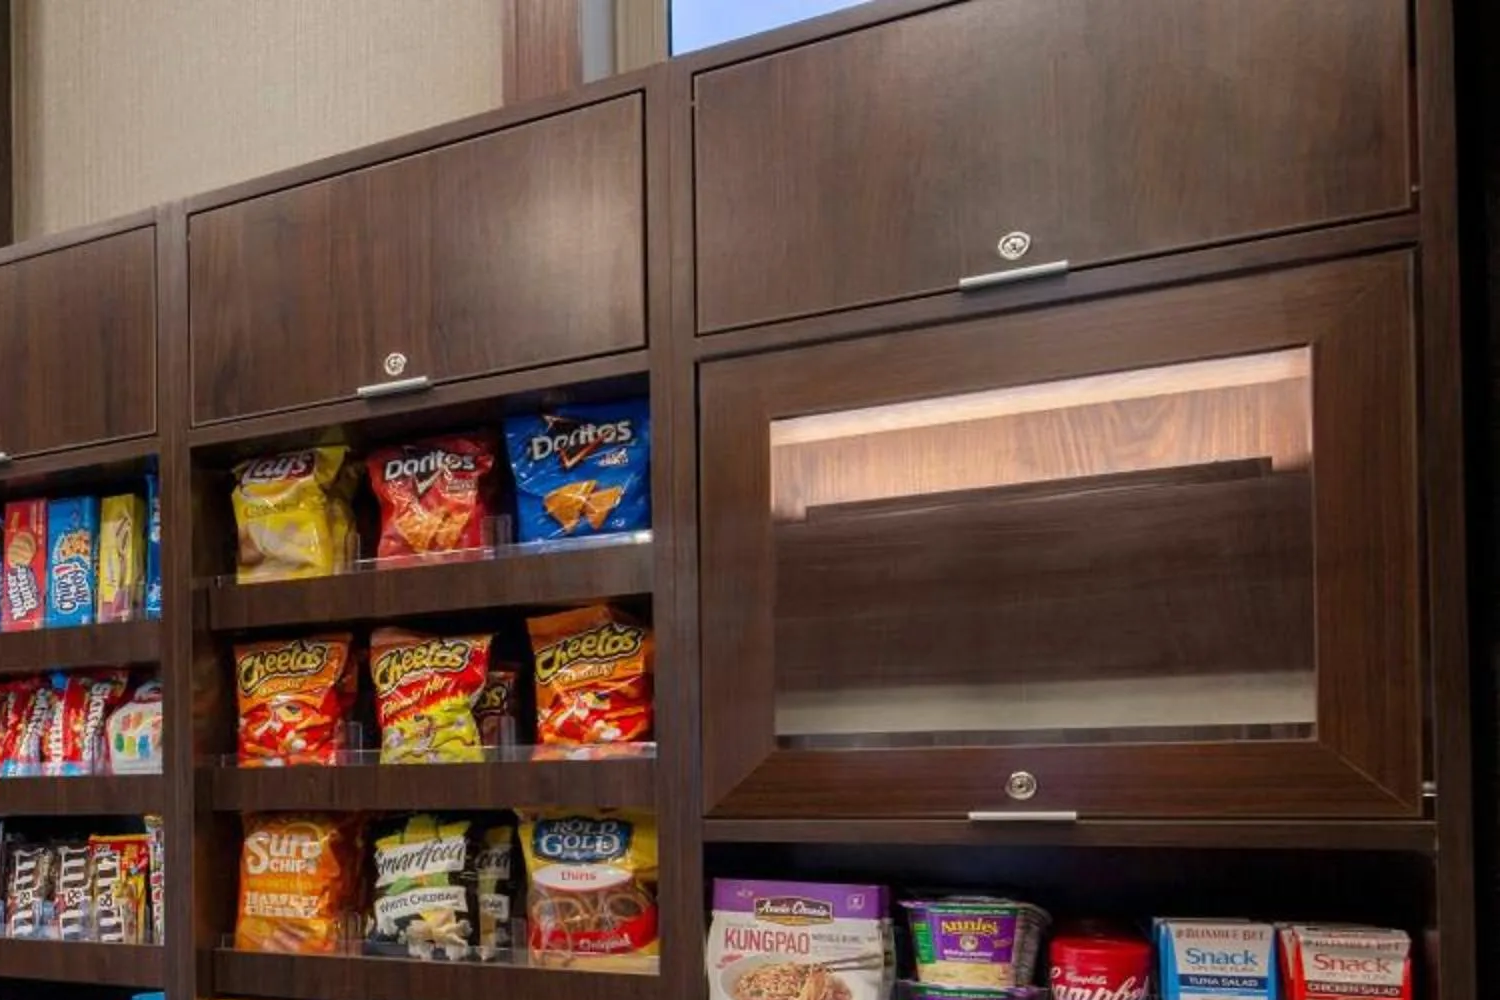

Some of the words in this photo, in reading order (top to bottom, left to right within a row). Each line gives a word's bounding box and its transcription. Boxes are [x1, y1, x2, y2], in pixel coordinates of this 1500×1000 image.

[531, 421, 632, 460] Doritos
[385, 450, 475, 481] Doritos
[240, 644, 327, 690] Cheetos
[375, 641, 469, 694] Cheetos
[535, 628, 640, 681] Cheetos
[552, 820, 620, 834] ROLD
[244, 831, 322, 874] Sun
[540, 833, 621, 856] GOLD
[1185, 947, 1259, 966] Snack
[1313, 953, 1392, 974] Snack
[1188, 975, 1220, 986] TUNA
